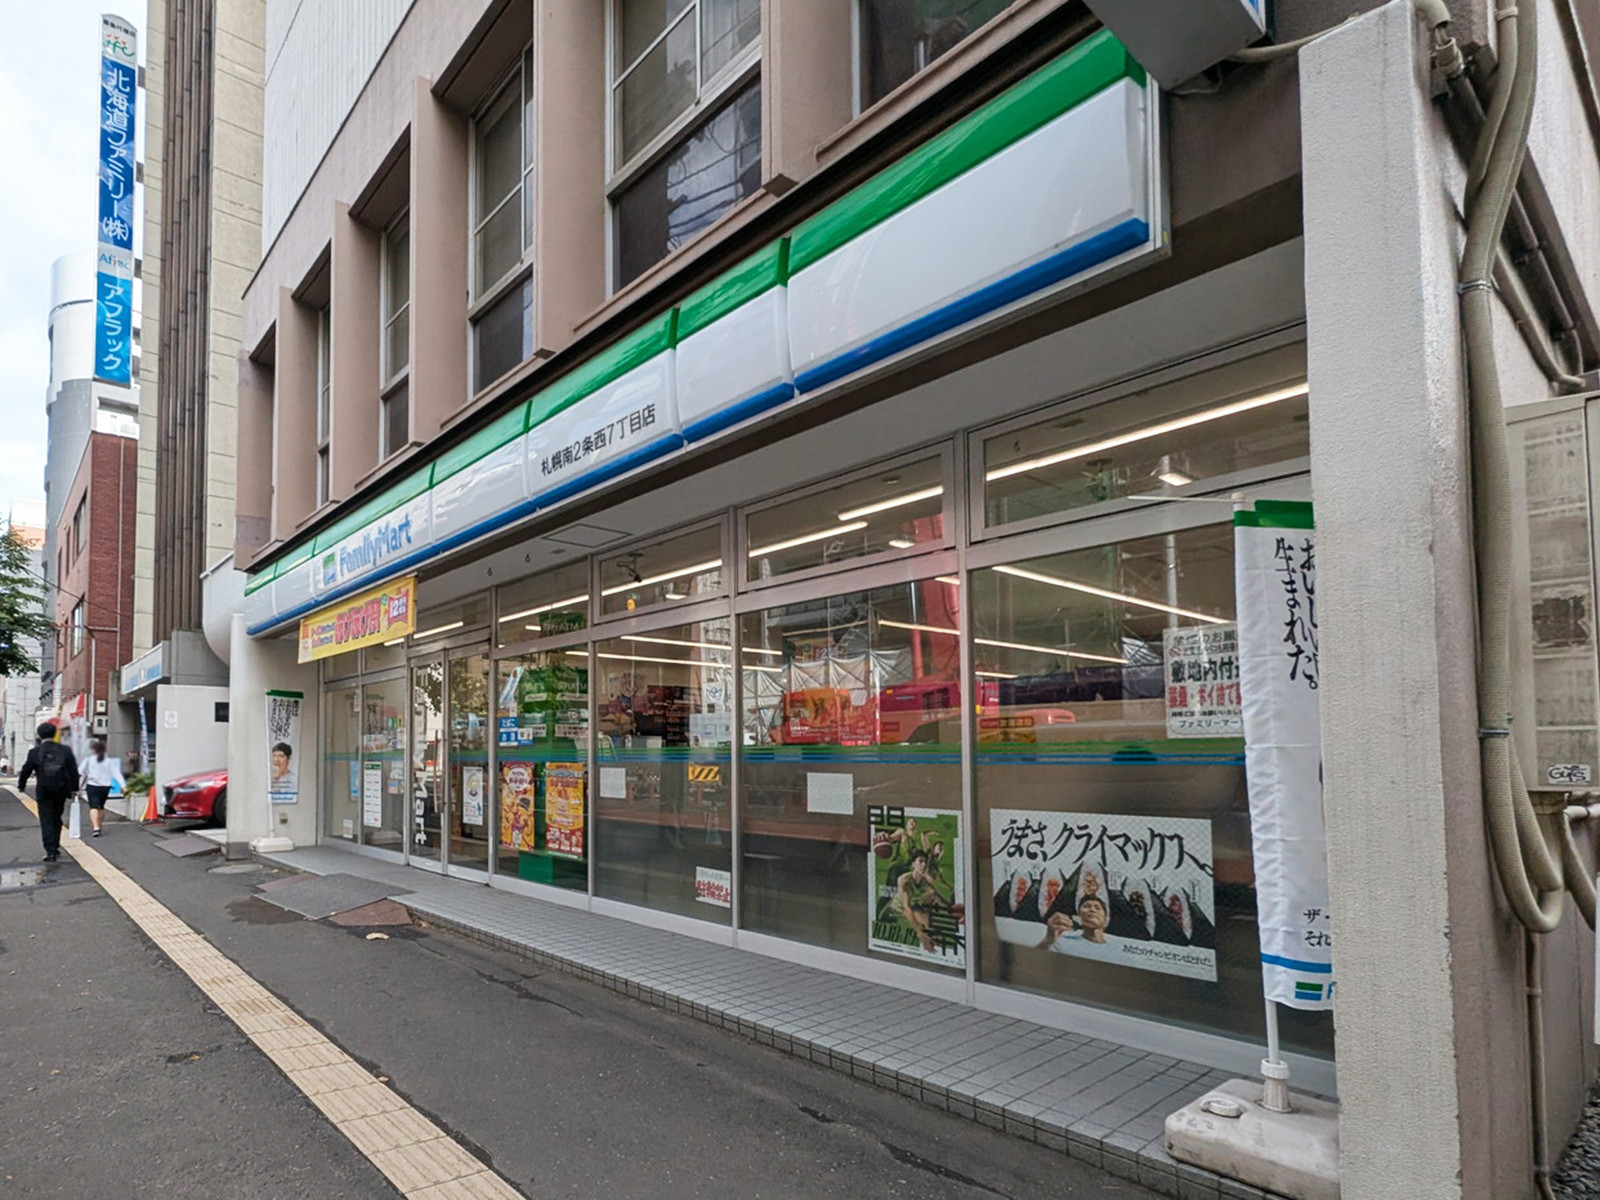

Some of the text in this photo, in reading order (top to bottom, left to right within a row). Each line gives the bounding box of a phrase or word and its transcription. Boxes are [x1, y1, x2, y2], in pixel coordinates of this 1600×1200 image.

[102, 282, 125, 371] アフラック
[541, 403, 656, 477] 札幌南2条西7丁目店
[339, 512, 412, 577] FamilyMart
[1275, 537, 1318, 690] 生まれた。
